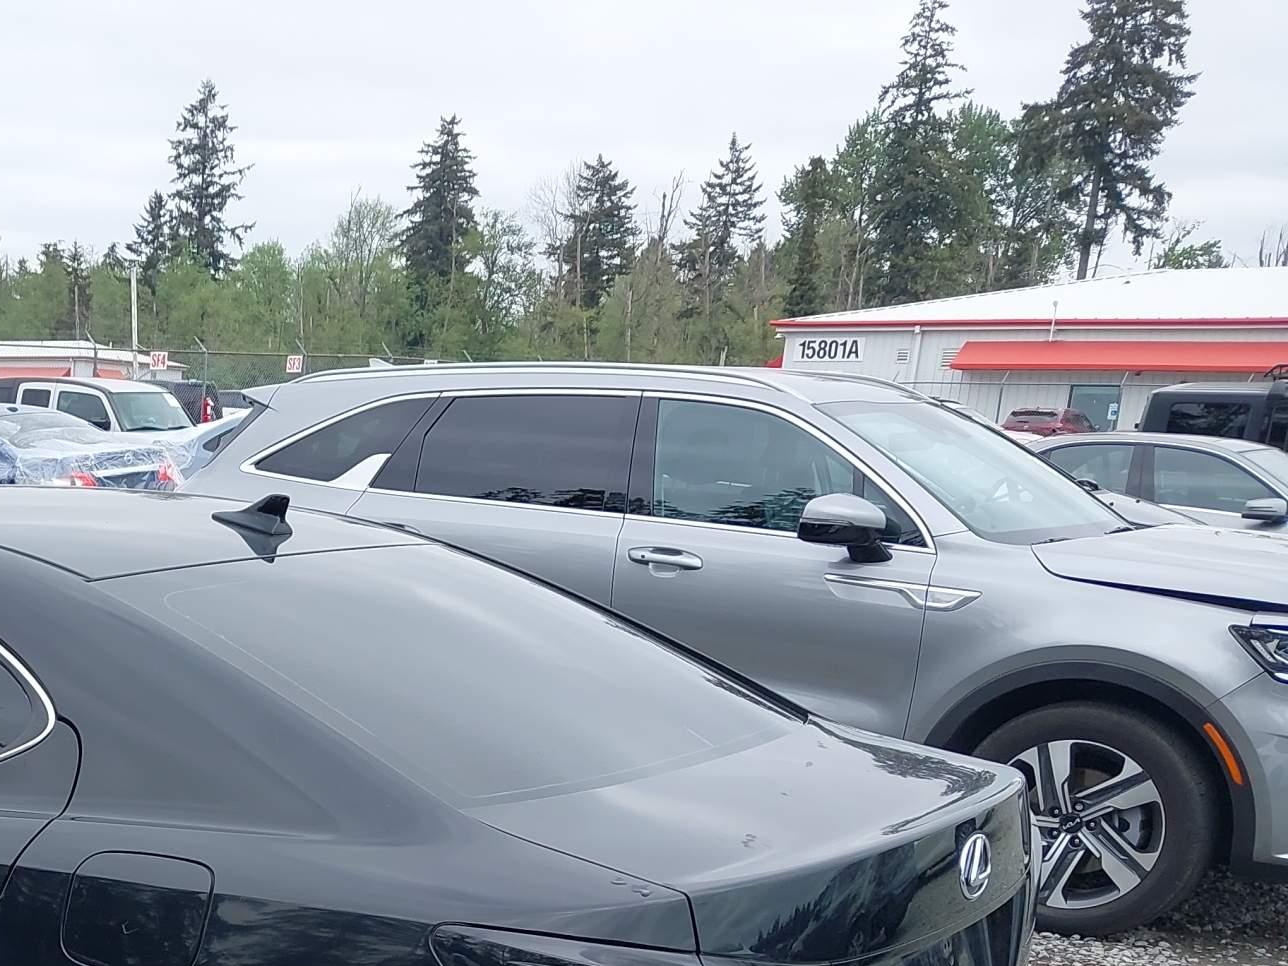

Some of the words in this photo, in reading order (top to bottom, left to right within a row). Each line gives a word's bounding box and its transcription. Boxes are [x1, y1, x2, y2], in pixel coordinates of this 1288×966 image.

[798, 339, 860, 360] 15801A
[152, 354, 166, 368] SF4
[288, 358, 301, 370] SF3
